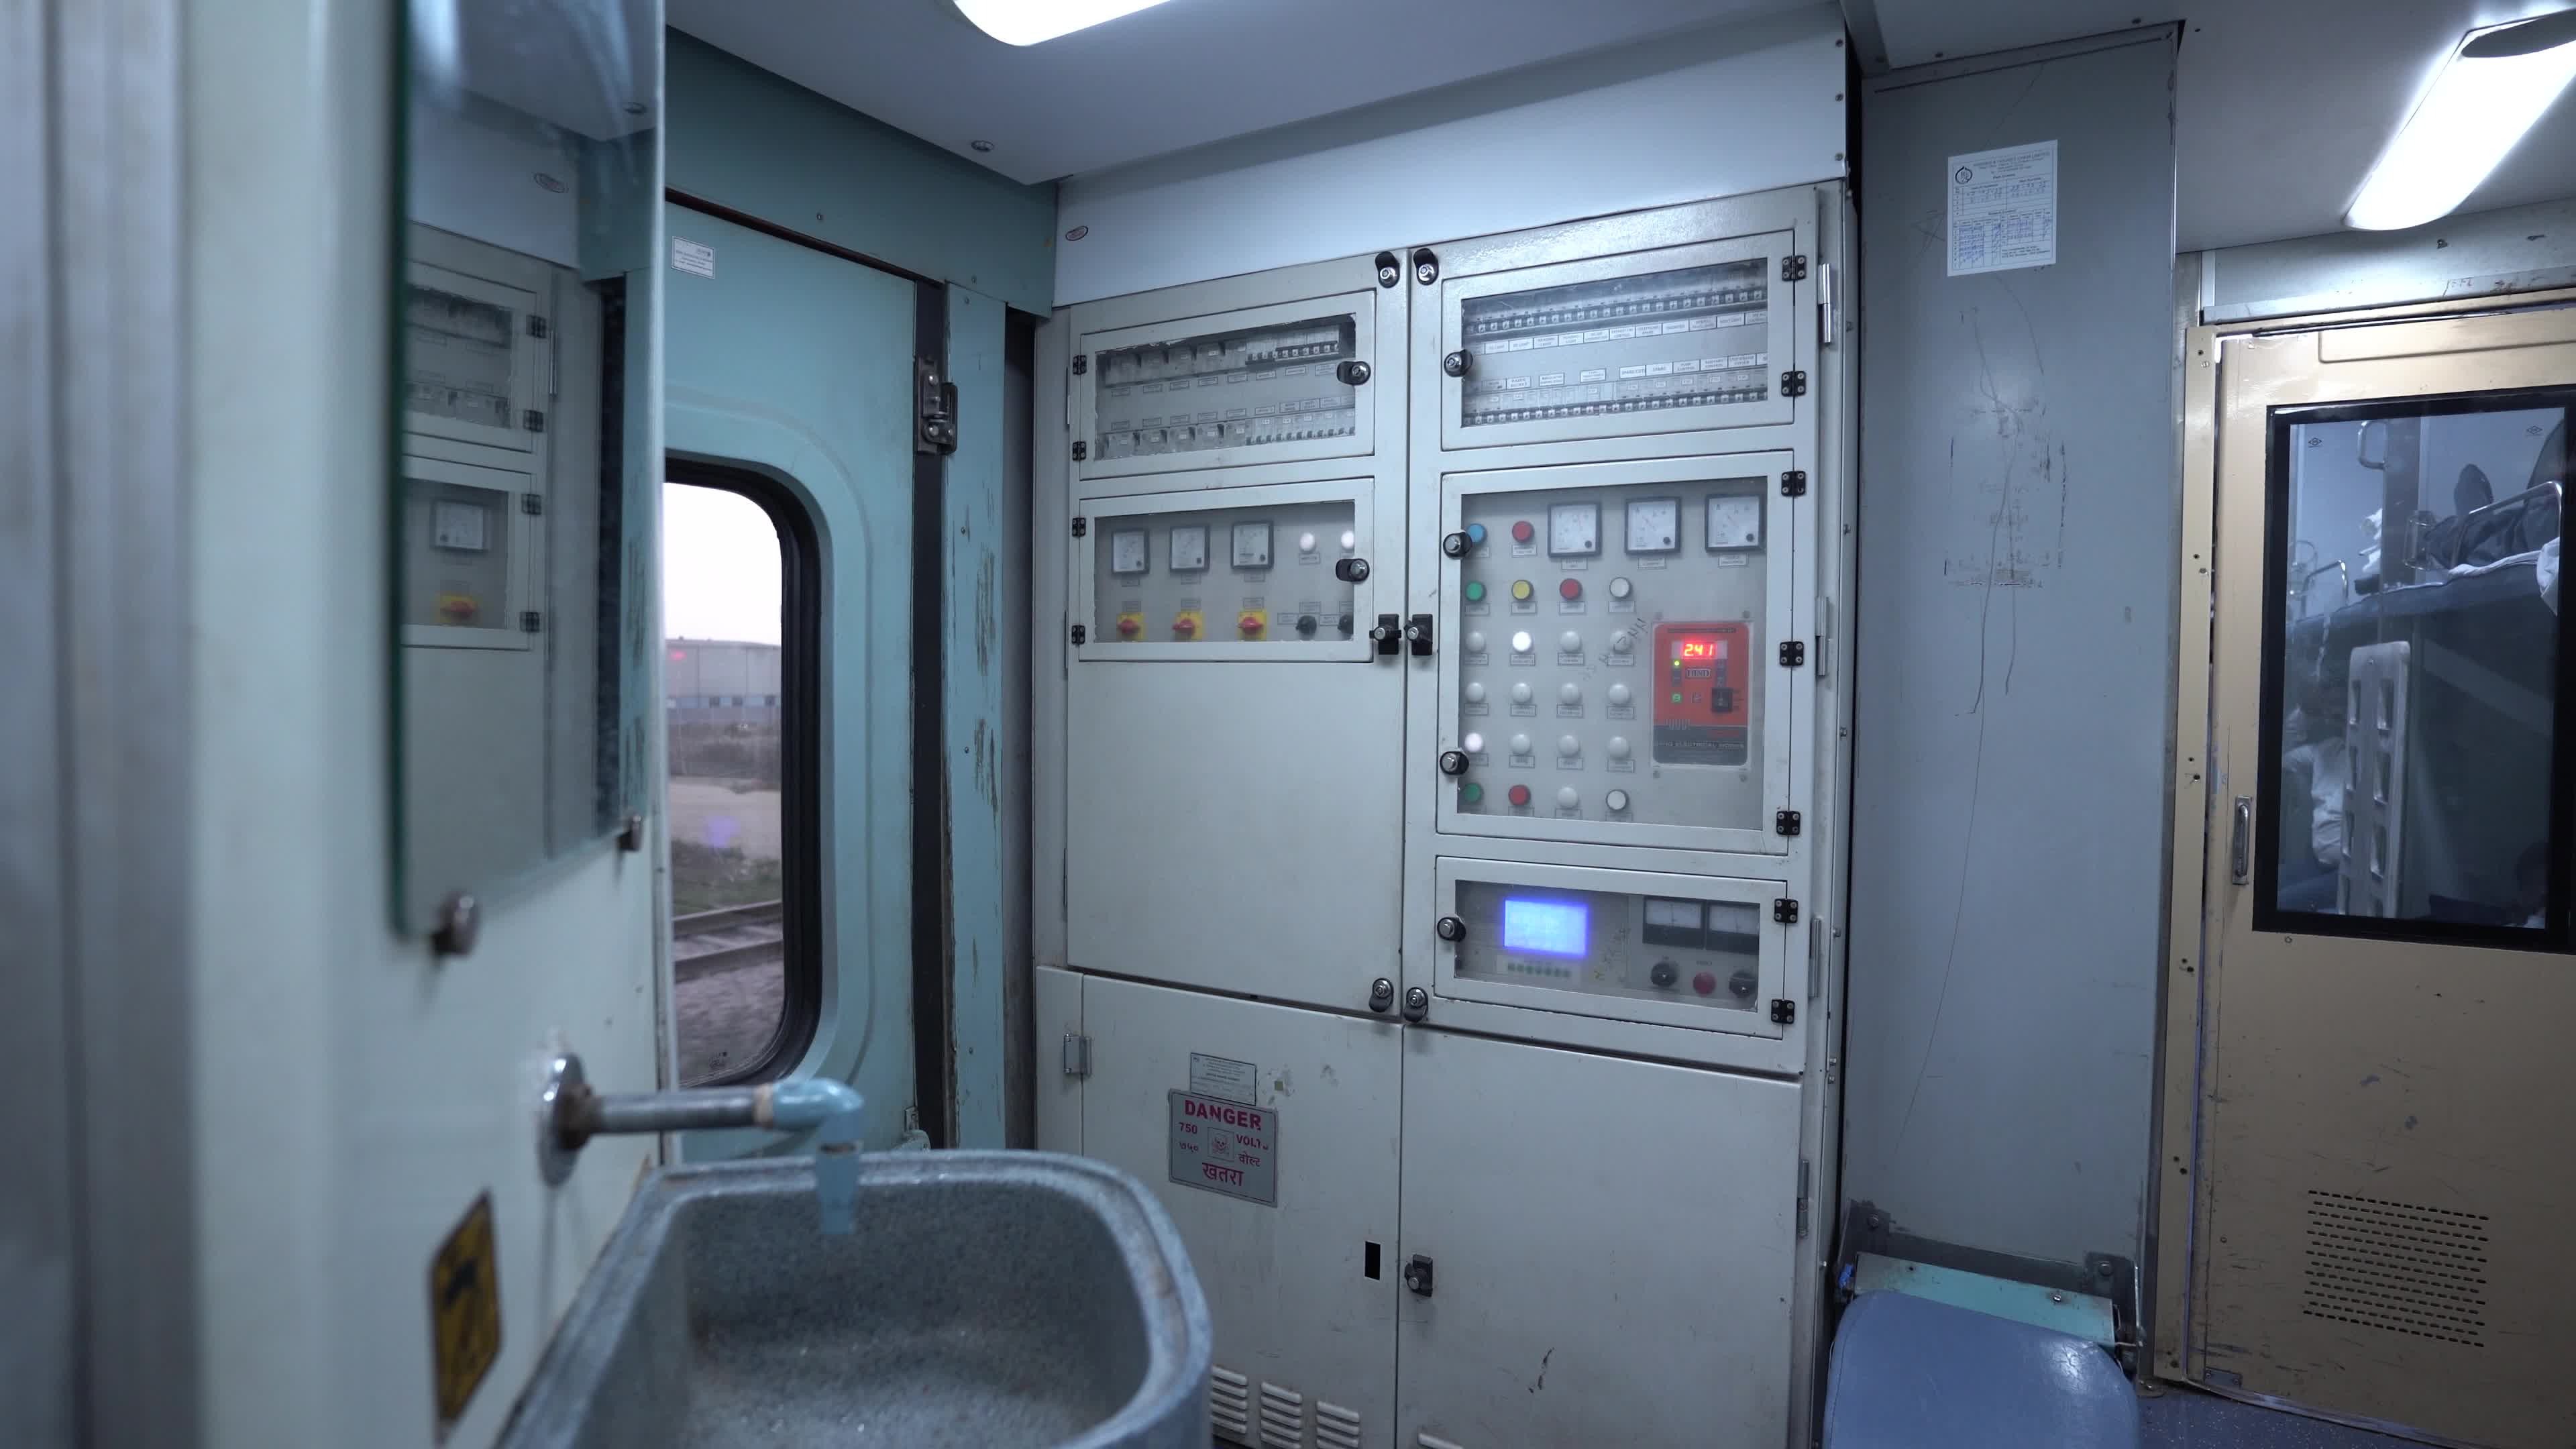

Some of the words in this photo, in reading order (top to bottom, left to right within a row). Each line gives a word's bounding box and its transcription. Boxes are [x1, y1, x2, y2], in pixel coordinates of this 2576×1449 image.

[1185, 1099, 1262, 1131] DANGER
[1179, 1122, 1198, 1134] 750
[1201, 1162, 1245, 1187] खतरा
